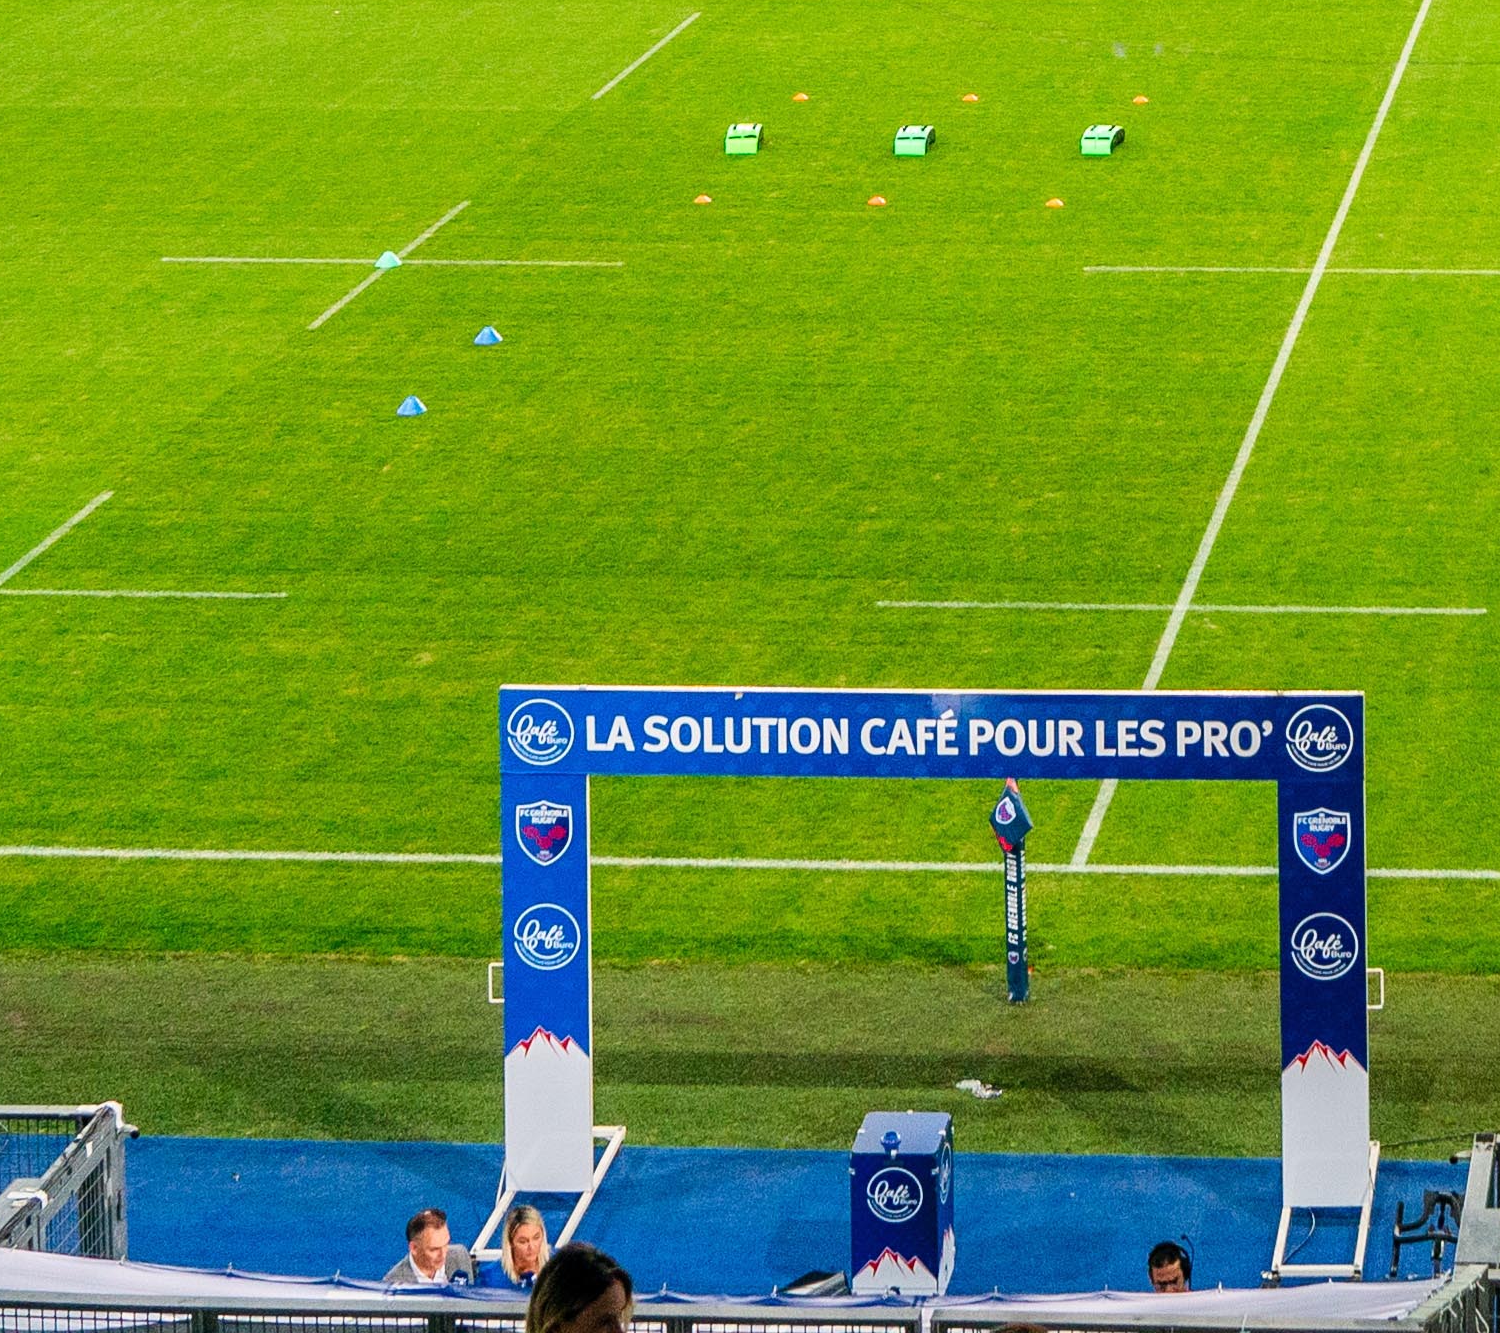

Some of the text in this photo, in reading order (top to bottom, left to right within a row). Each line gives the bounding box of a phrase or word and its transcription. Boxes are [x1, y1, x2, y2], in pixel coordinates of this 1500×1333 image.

[586, 715, 636, 752] LA
[642, 715, 849, 755] SOLUTION
[860, 709, 959, 757] CAFÉ
[968, 718, 1085, 757] POUR
[1095, 719, 1166, 758] LES
[1325, 741, 1347, 751] Buro
